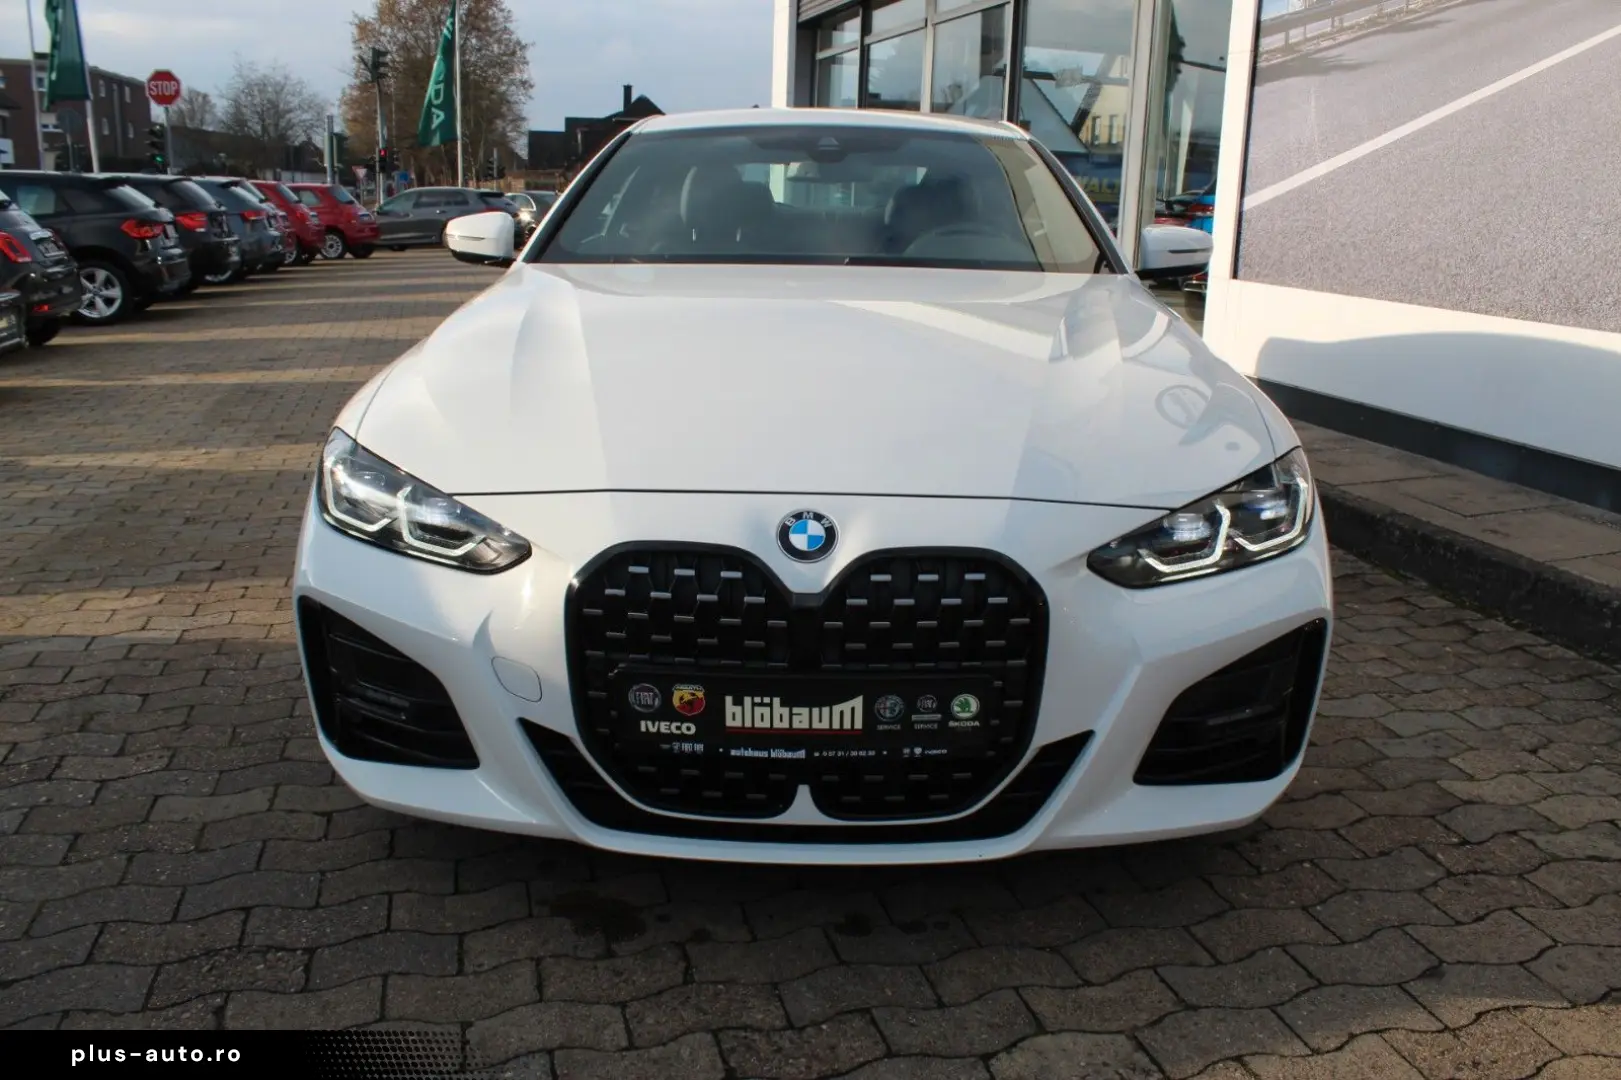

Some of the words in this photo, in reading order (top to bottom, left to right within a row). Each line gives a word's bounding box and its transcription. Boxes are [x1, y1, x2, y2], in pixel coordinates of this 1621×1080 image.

[149, 81, 178, 96] STOP
[784, 511, 832, 527] BMW
[639, 720, 697, 735] IVECO
[730, 747, 768, 757] autohaus
